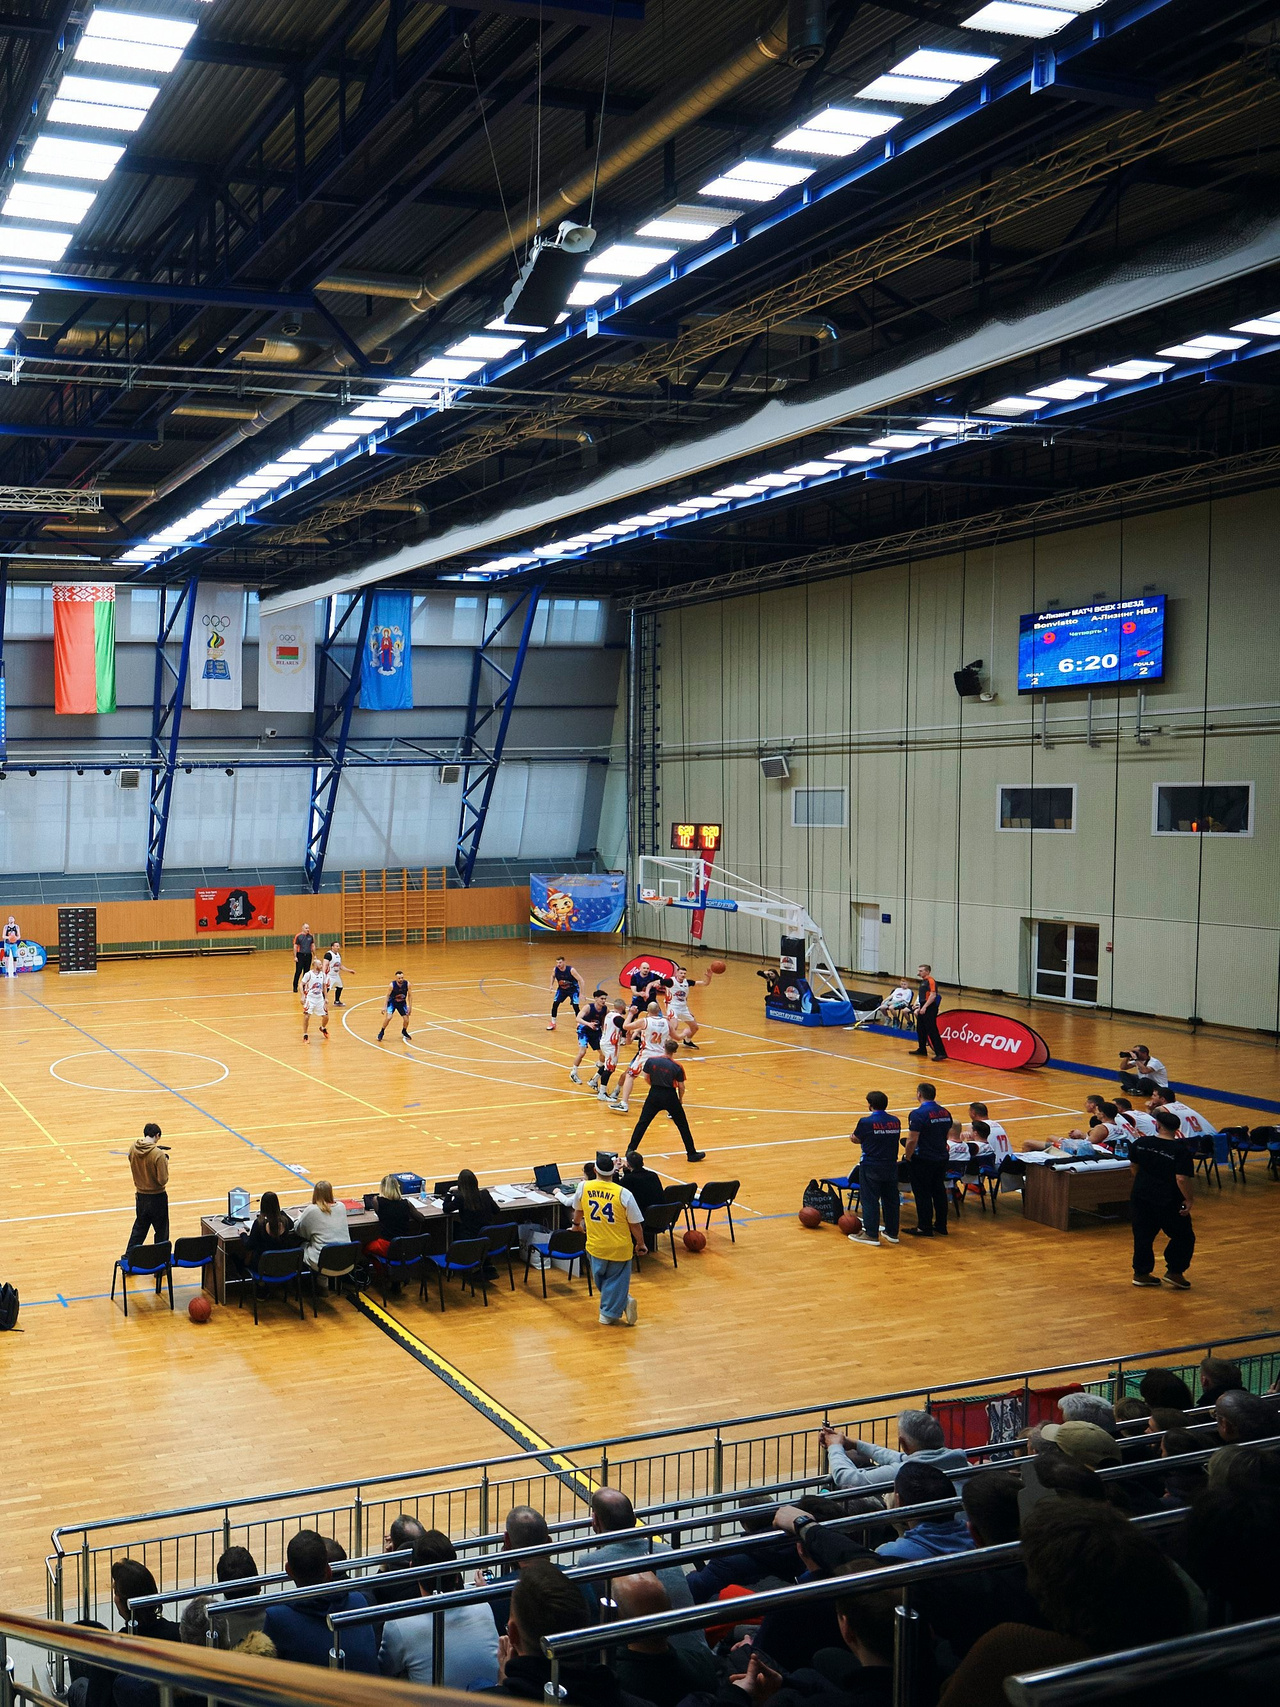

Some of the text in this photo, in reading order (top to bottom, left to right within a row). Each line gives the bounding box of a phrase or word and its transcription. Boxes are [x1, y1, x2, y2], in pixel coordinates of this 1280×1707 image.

[1072, 606, 1093, 616] МАТЧ
[1094, 603, 1116, 612] ВСЕХ
[1136, 606, 1158, 616] НБЛ
[1122, 621, 1136, 634] 9
[1043, 632, 1056, 644] 9
[1058, 653, 1118, 673] 6:20
[1139, 667, 1148, 675] 2
[680, 835, 690, 847] 10
[705, 836, 715, 848] 10
[1185, 1115, 1203, 1132] 13
[996, 1134, 1009, 1152] 17
[587, 1190, 615, 1201] BRYANT
[588, 1199, 615, 1223] 24
